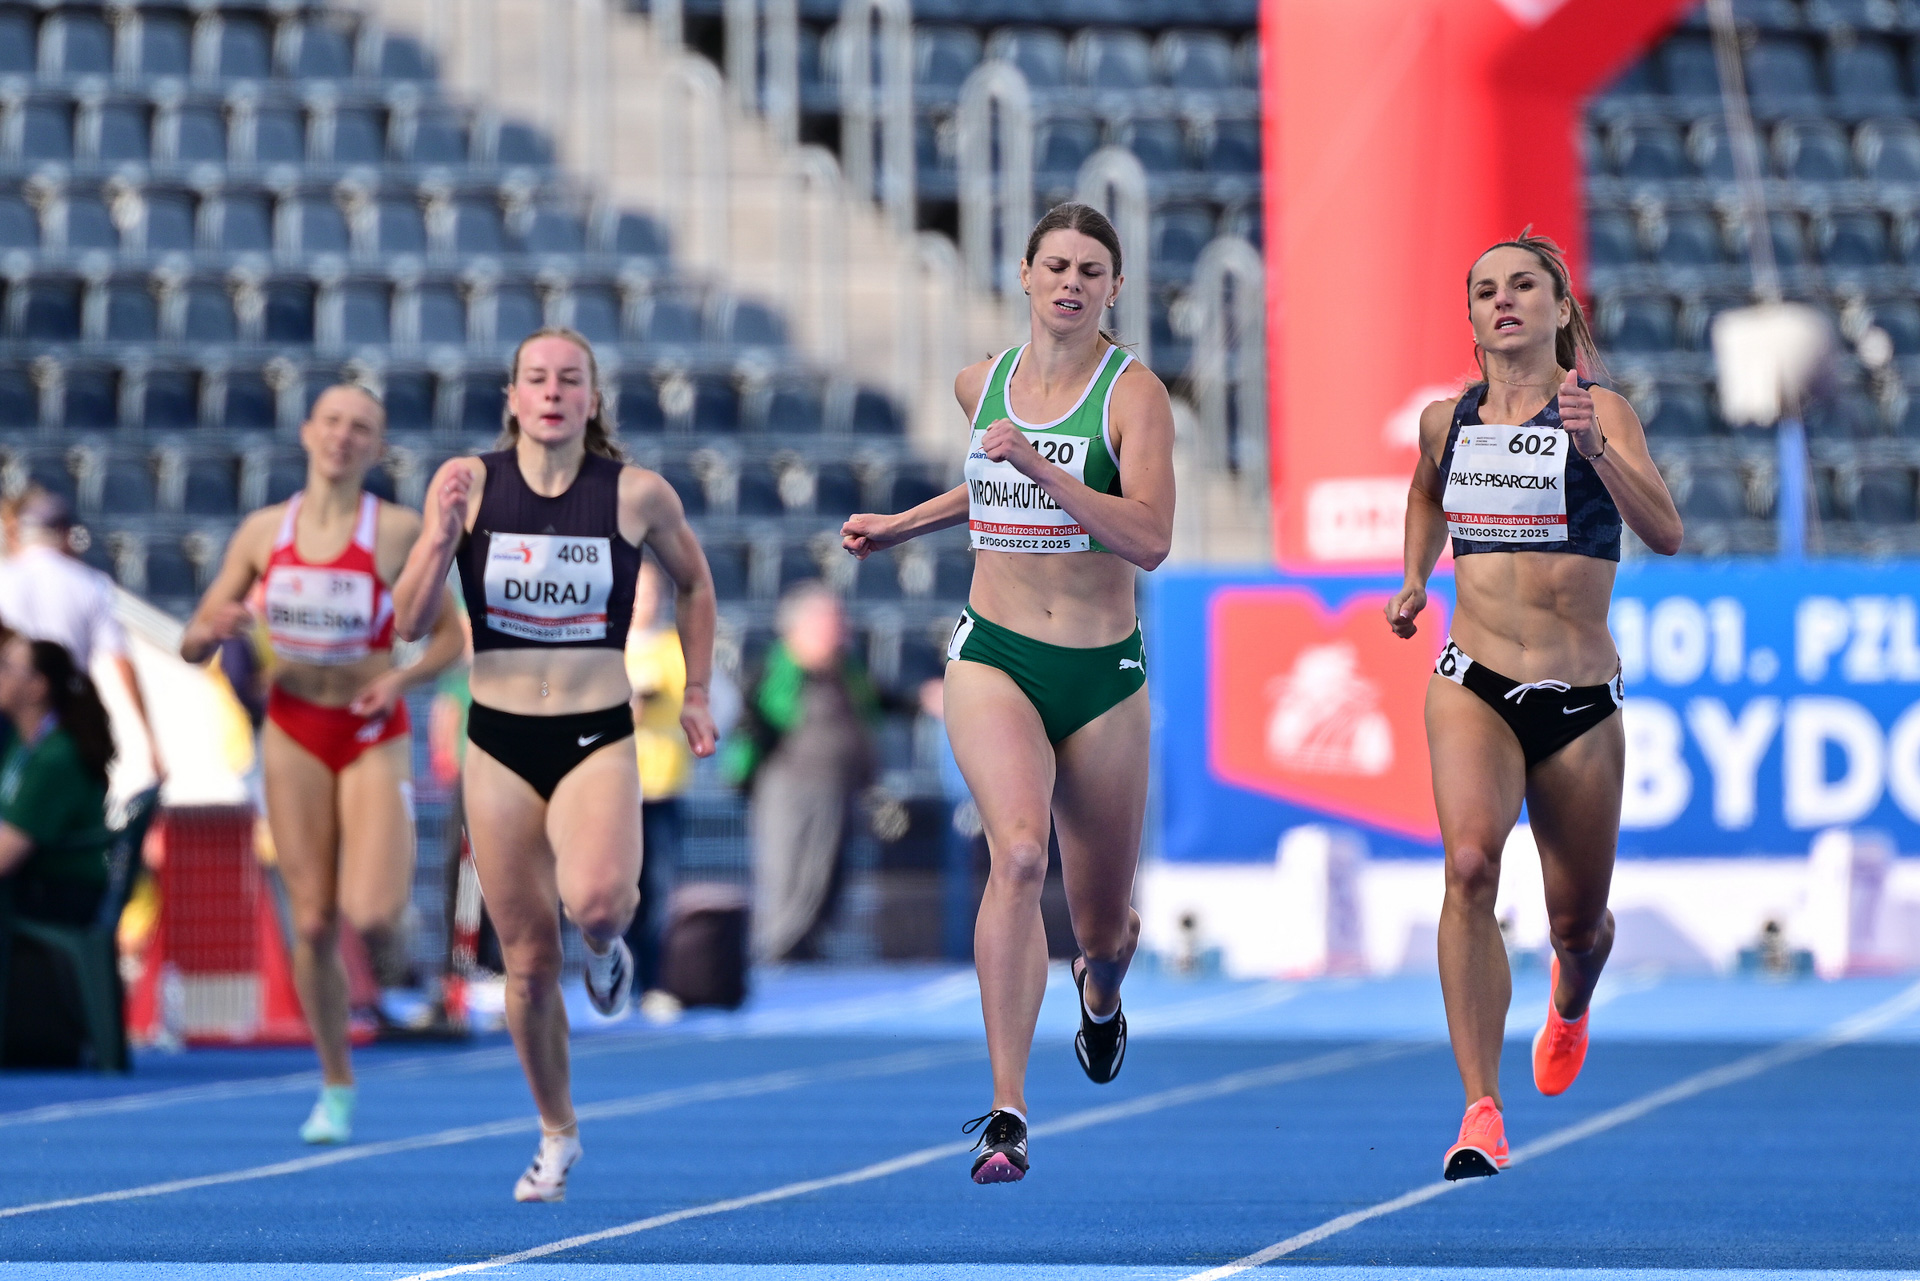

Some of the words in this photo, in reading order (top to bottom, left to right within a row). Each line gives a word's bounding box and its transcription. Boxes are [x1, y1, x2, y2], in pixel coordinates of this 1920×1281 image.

[1508, 433, 1558, 456] 602
[1449, 472, 1558, 490] PAŁYS-PISARCZUK
[1449, 513, 1461, 522] 101.
[1461, 514, 1479, 523] PZLA
[1480, 515, 1530, 524] Mistrzostwa
[1532, 515, 1560, 524] Polski
[983, 524, 998, 533] PZLA
[998, 525, 1051, 535] Mistrzostwa
[1052, 526, 1081, 535] Polski
[1458, 527, 1517, 538] BYDGOSZCZ
[1520, 528, 1550, 538] 2025
[979, 536, 1039, 549] BYDGOSZCZ
[1041, 539, 1072, 549] 2025
[557, 544, 599, 564] 408
[504, 578, 592, 604] DURAJ
[1611, 594, 1779, 687] 101.
[1619, 694, 1920, 832] BYD
